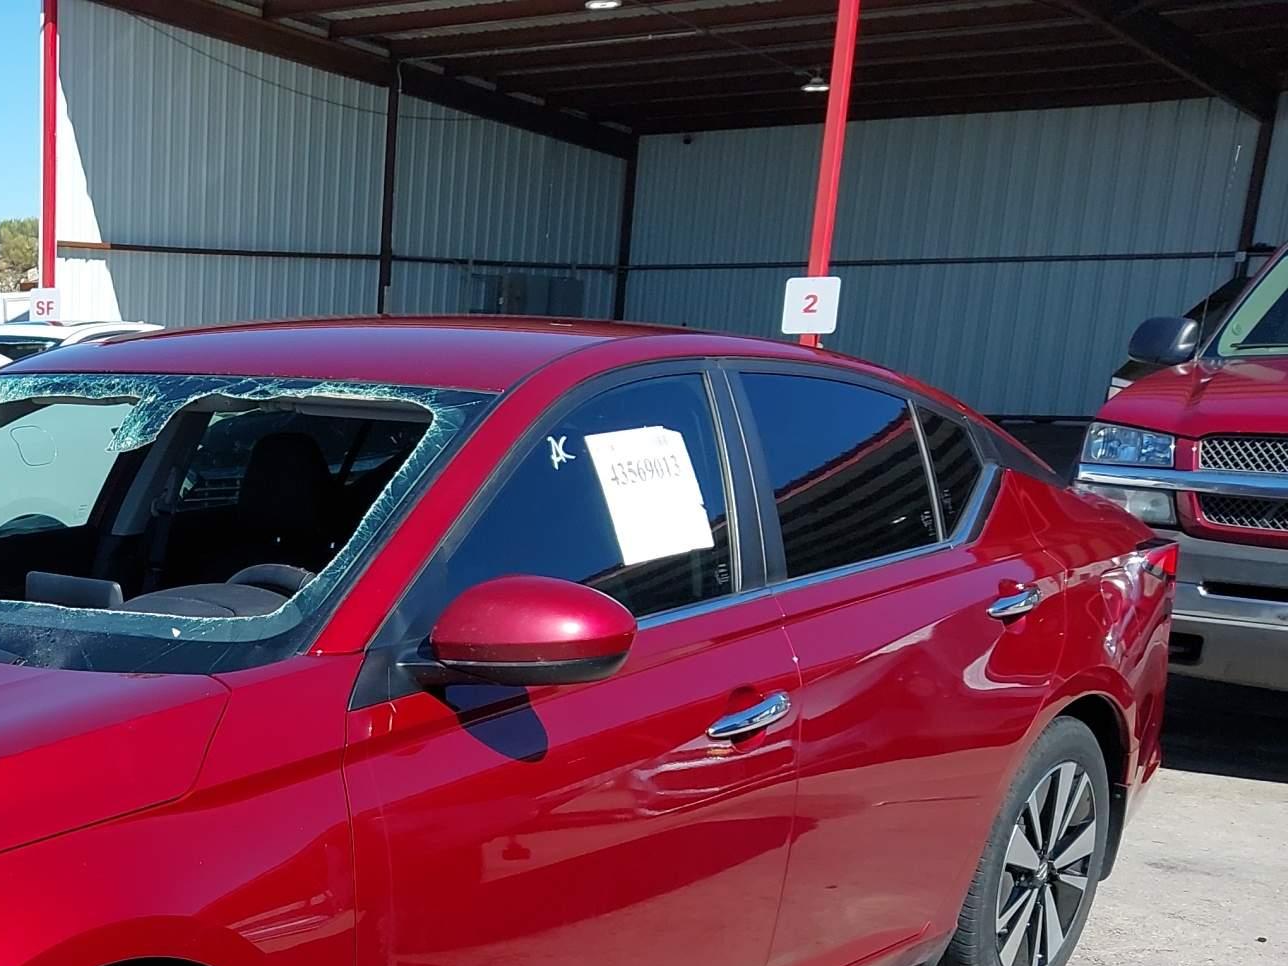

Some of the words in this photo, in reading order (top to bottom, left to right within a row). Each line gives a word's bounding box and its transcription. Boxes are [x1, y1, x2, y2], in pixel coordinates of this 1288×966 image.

[36, 300, 55, 316] SF
[802, 294, 818, 313] 2
[611, 454, 681, 486] 43569013
